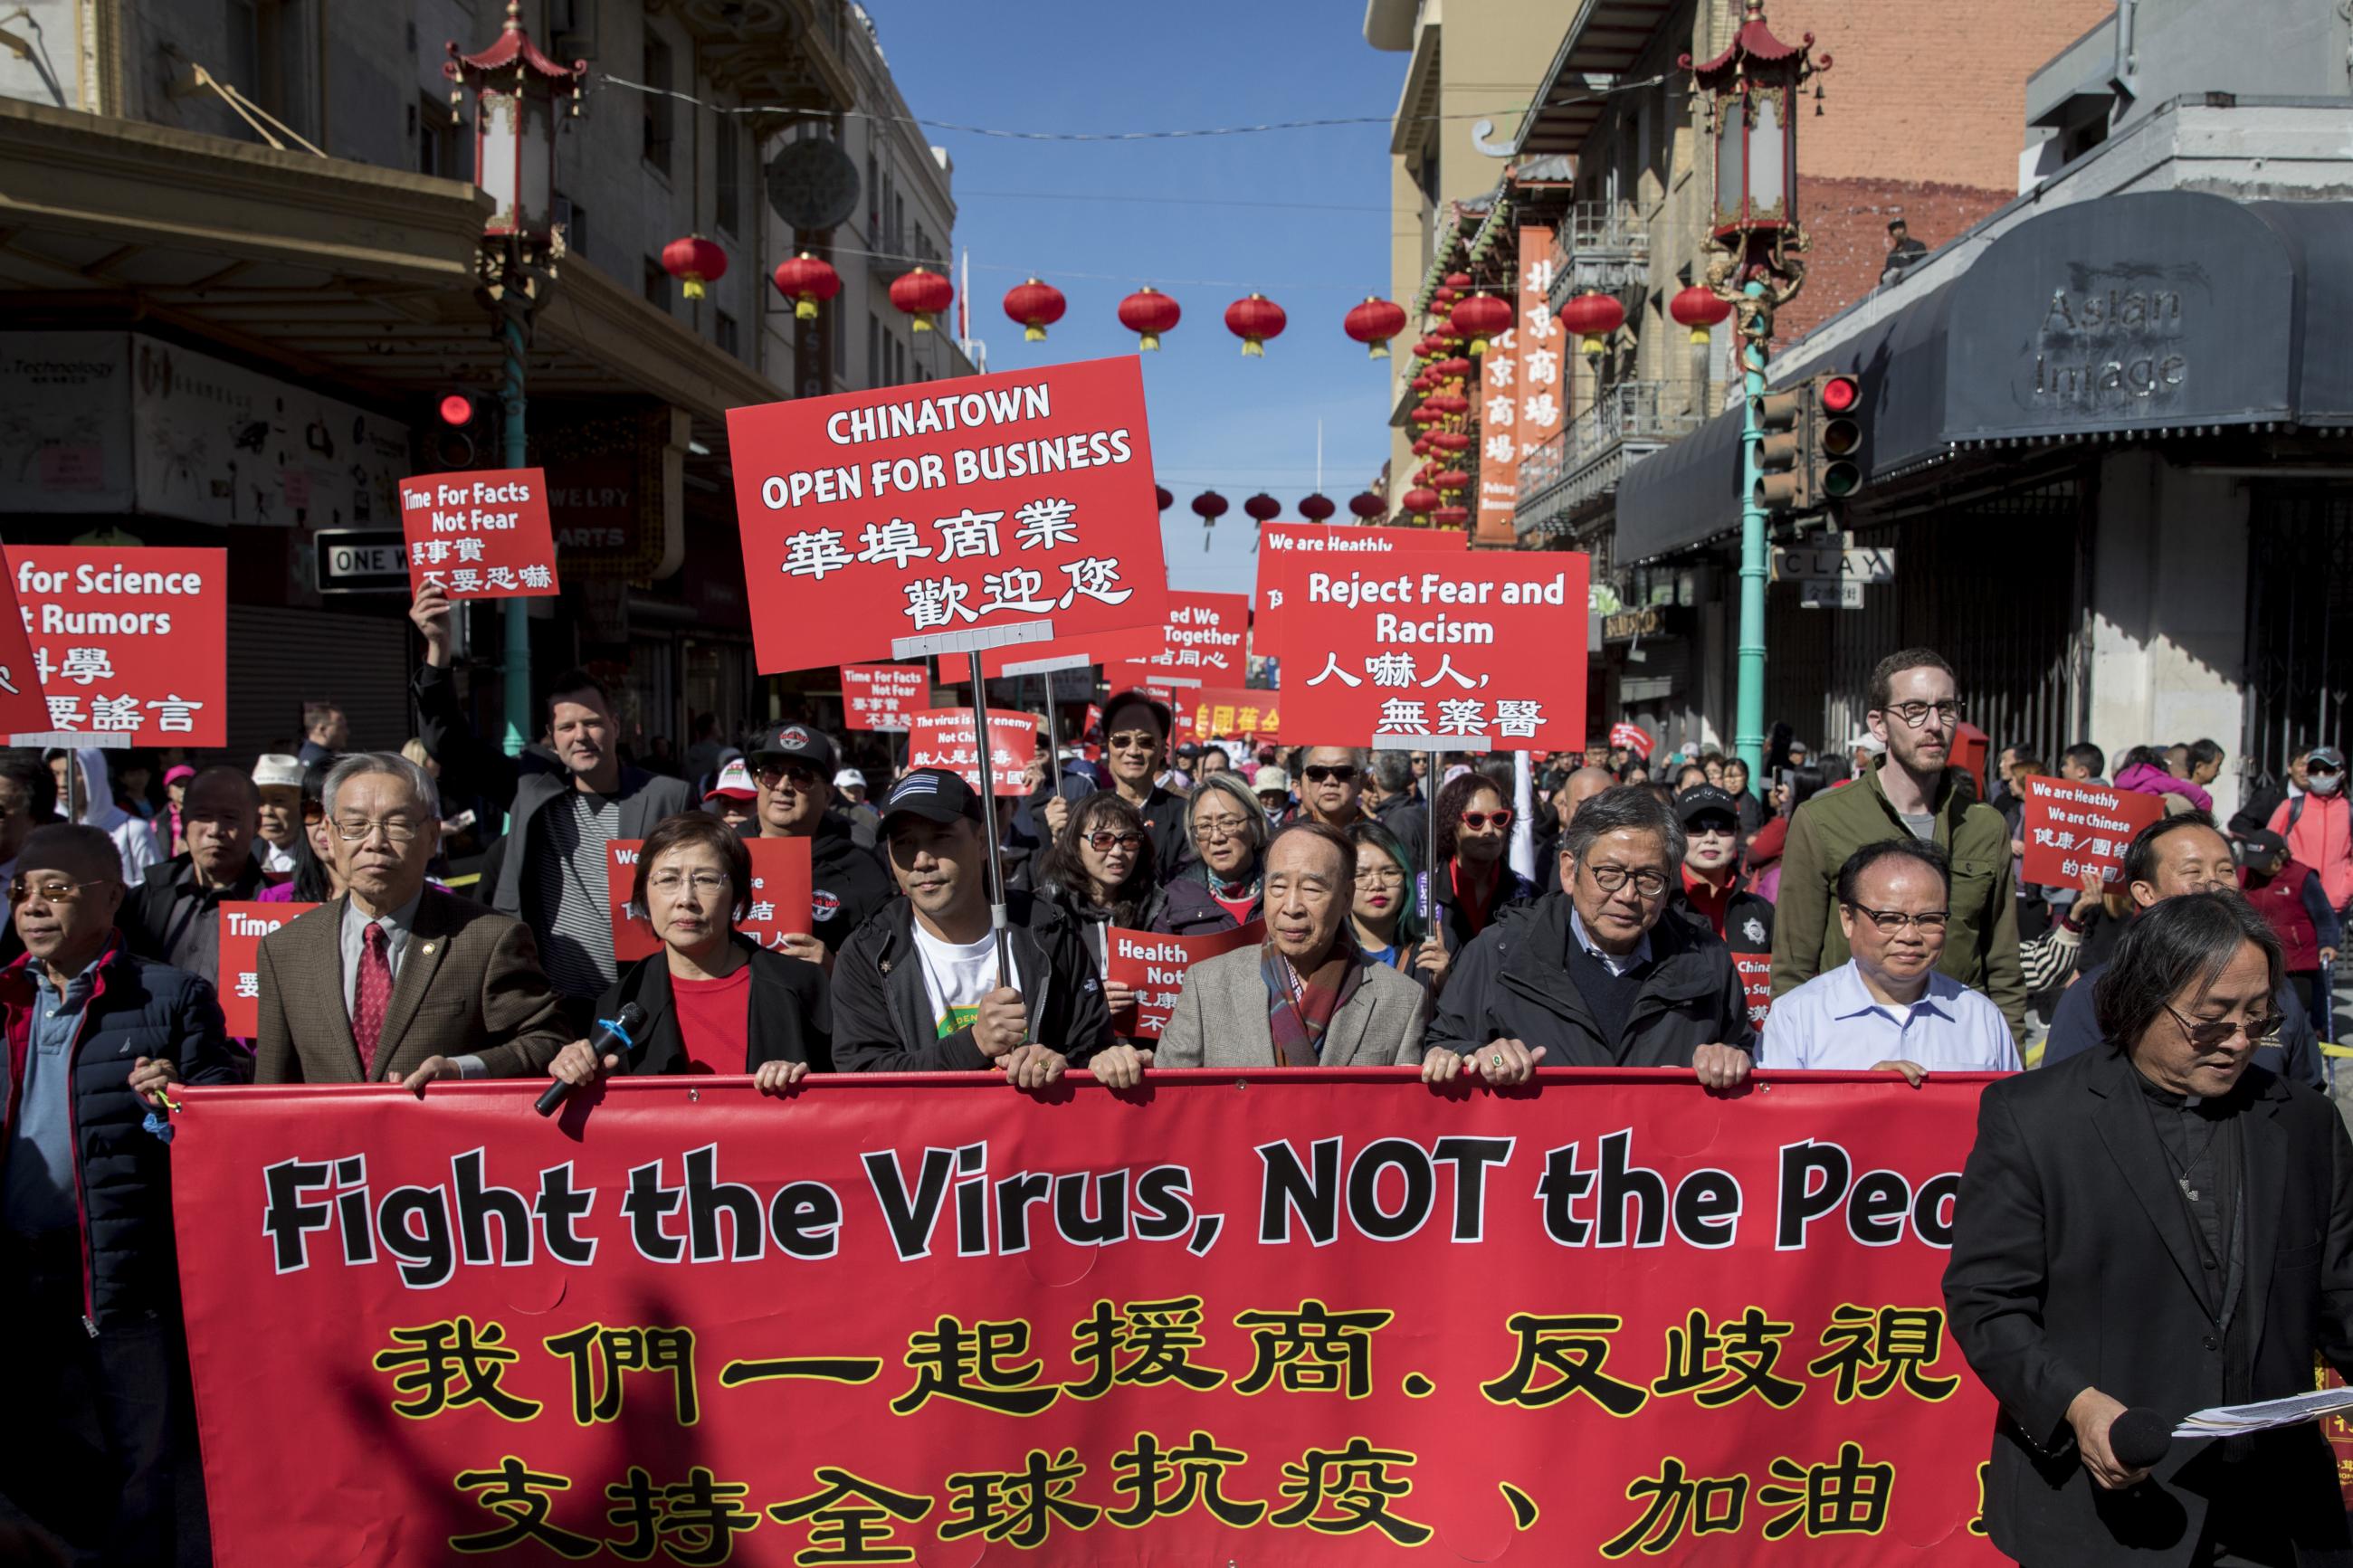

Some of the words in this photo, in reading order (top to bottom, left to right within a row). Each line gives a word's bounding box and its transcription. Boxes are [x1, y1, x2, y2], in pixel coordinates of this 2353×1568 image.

[2037, 355, 2185, 396] Image
[826, 382, 1052, 446] CHINATOWN
[761, 463, 862, 509] OPEN
[871, 451, 948, 498] FOR
[955, 429, 1131, 486] BUSINESS
[404, 489, 432, 510] Time
[438, 484, 469, 507] For
[473, 481, 529, 504] Facts
[432, 511, 467, 532] Not
[471, 508, 519, 531] Fear
[558, 527, 625, 547] ARTS
[781, 498, 1080, 580] 華埠商業
[1268, 533, 1293, 550] We
[1297, 537, 1323, 551] are
[338, 550, 386, 571] ONE
[412, 537, 485, 565] 要事實
[1785, 554, 1880, 575] CLAY
[18, 561, 69, 594] for
[76, 564, 202, 594] Science
[423, 565, 553, 593] 不要恐嚇
[1309, 571, 1414, 610] Reject
[1420, 572, 1495, 605] Fear
[1500, 571, 1566, 605] and
[903, 556, 1134, 631] 歡迎您
[42, 603, 172, 634] Rumors
[1194, 607, 1220, 625] We
[1376, 613, 1494, 644] Racism
[1163, 625, 1241, 647] Together
[844, 670, 871, 683] Time
[874, 670, 891, 682] For
[893, 672, 921, 684] Facts
[872, 684, 891, 696] Not
[892, 684, 916, 696] Fear
[917, 717, 933, 727] The
[934, 716, 959, 727] virus
[961, 714, 971, 725] is
[994, 717, 1033, 731] enemy
[1376, 697, 1548, 738] 無藥醫
[938, 732, 956, 744] Not
[2032, 782, 2051, 796] We
[2053, 787, 2073, 801] are
[2074, 789, 2119, 811] Heathly
[2048, 806, 2065, 821] We
[2067, 812, 2085, 825] are
[2086, 813, 2130, 832] Chinese
[227, 913, 281, 936] Time
[1118, 938, 1188, 963] Health
[1139, 1014, 1167, 1031] 不
[262, 1145, 600, 1290] Fight
[620, 1142, 843, 1265] the
[858, 1139, 1225, 1259] Virus,
[1254, 1134, 1517, 1248] NOT
[1532, 1126, 1744, 1250] the
